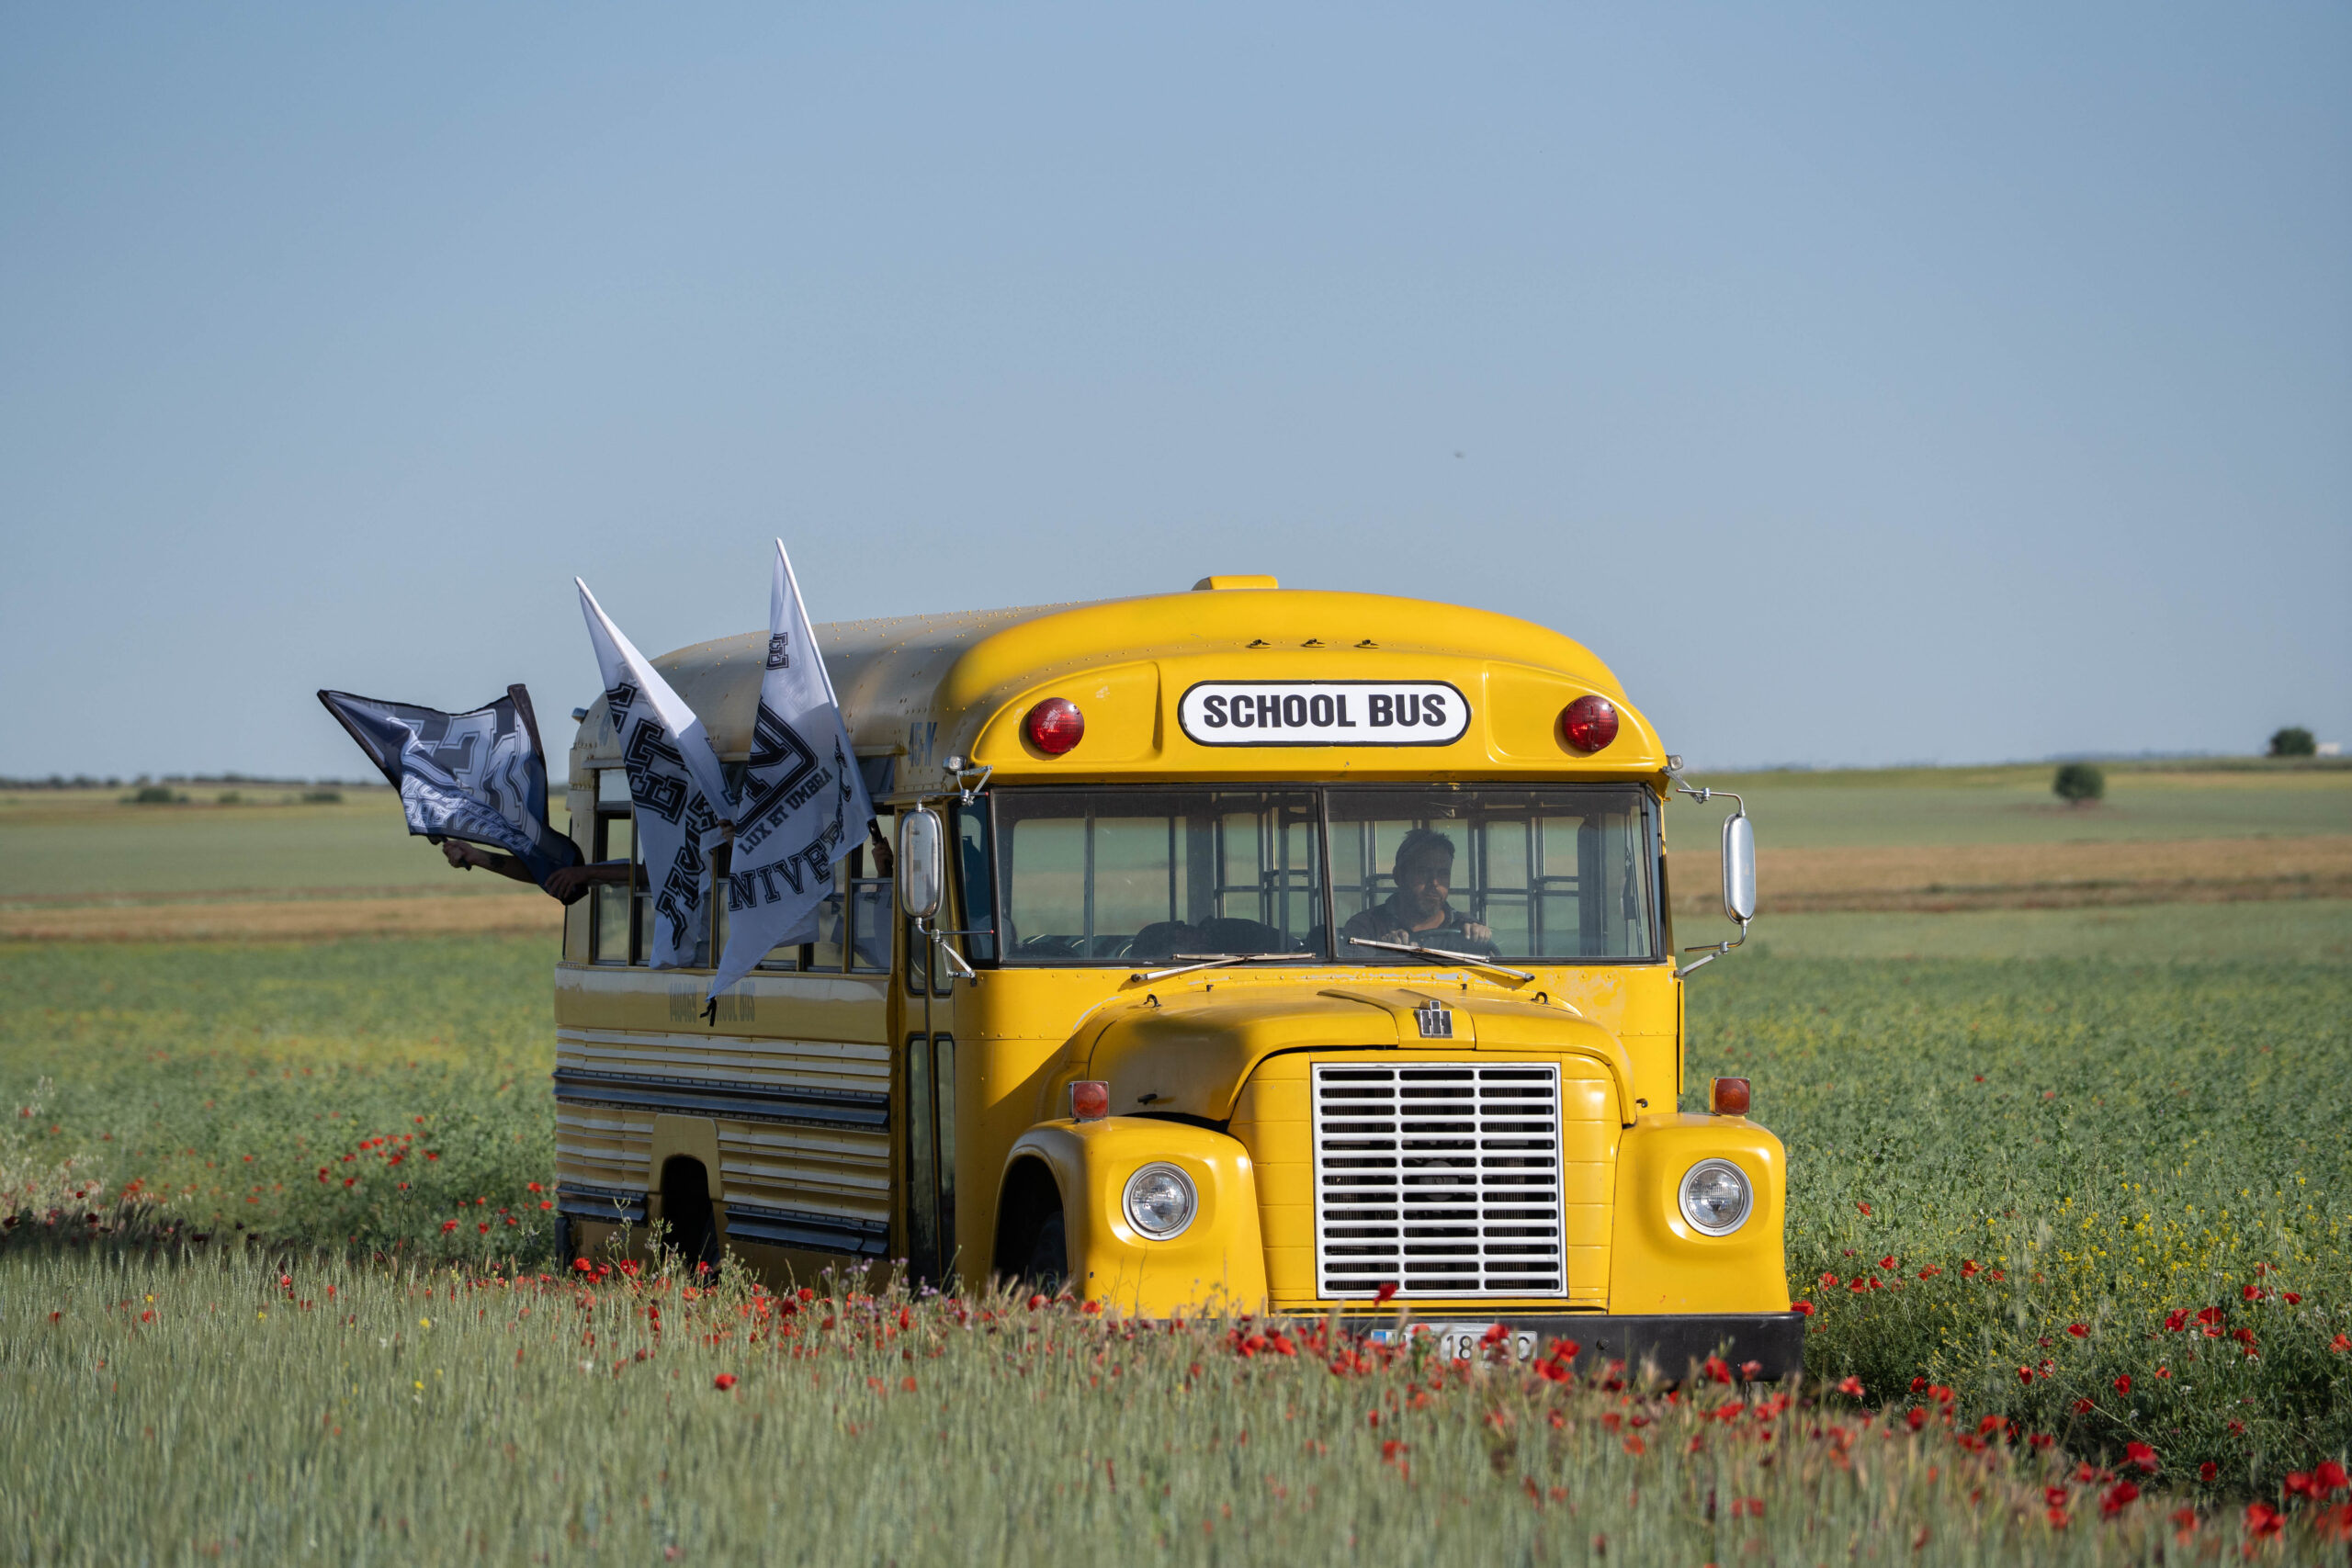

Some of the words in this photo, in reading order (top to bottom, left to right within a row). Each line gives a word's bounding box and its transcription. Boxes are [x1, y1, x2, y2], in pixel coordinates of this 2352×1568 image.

[1203, 694, 1356, 728] SCHOOL
[1368, 694, 1446, 728] BUS
[738, 821, 772, 855] LUX
[766, 805, 790, 828] ET
[785, 766, 833, 811] UMBRA
